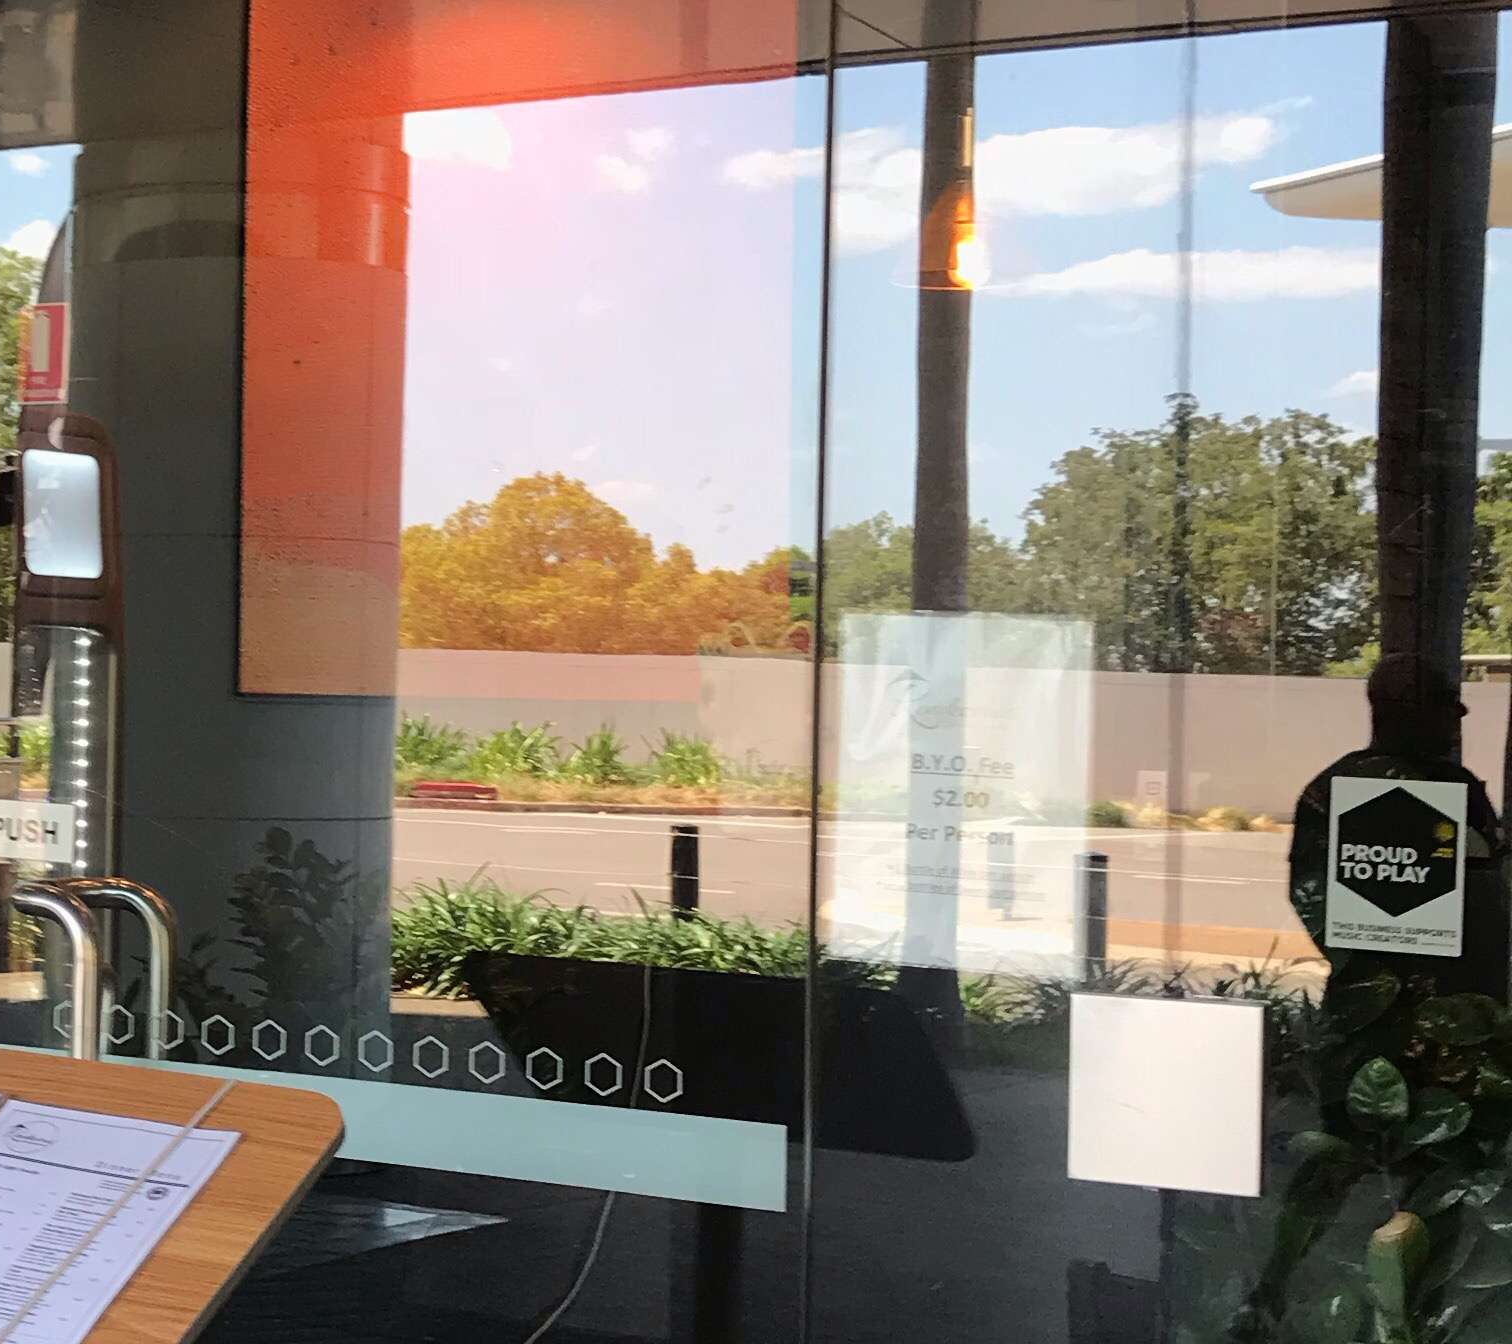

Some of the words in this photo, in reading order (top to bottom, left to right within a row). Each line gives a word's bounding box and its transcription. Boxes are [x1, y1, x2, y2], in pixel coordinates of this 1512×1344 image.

[979, 757, 1015, 775] Fee
[932, 789, 991, 808] $2.00
[905, 822, 940, 840] Per
[1341, 843, 1418, 865] PROUD
[1339, 861, 1373, 880] TO
[1377, 864, 1431, 884] PLAY
